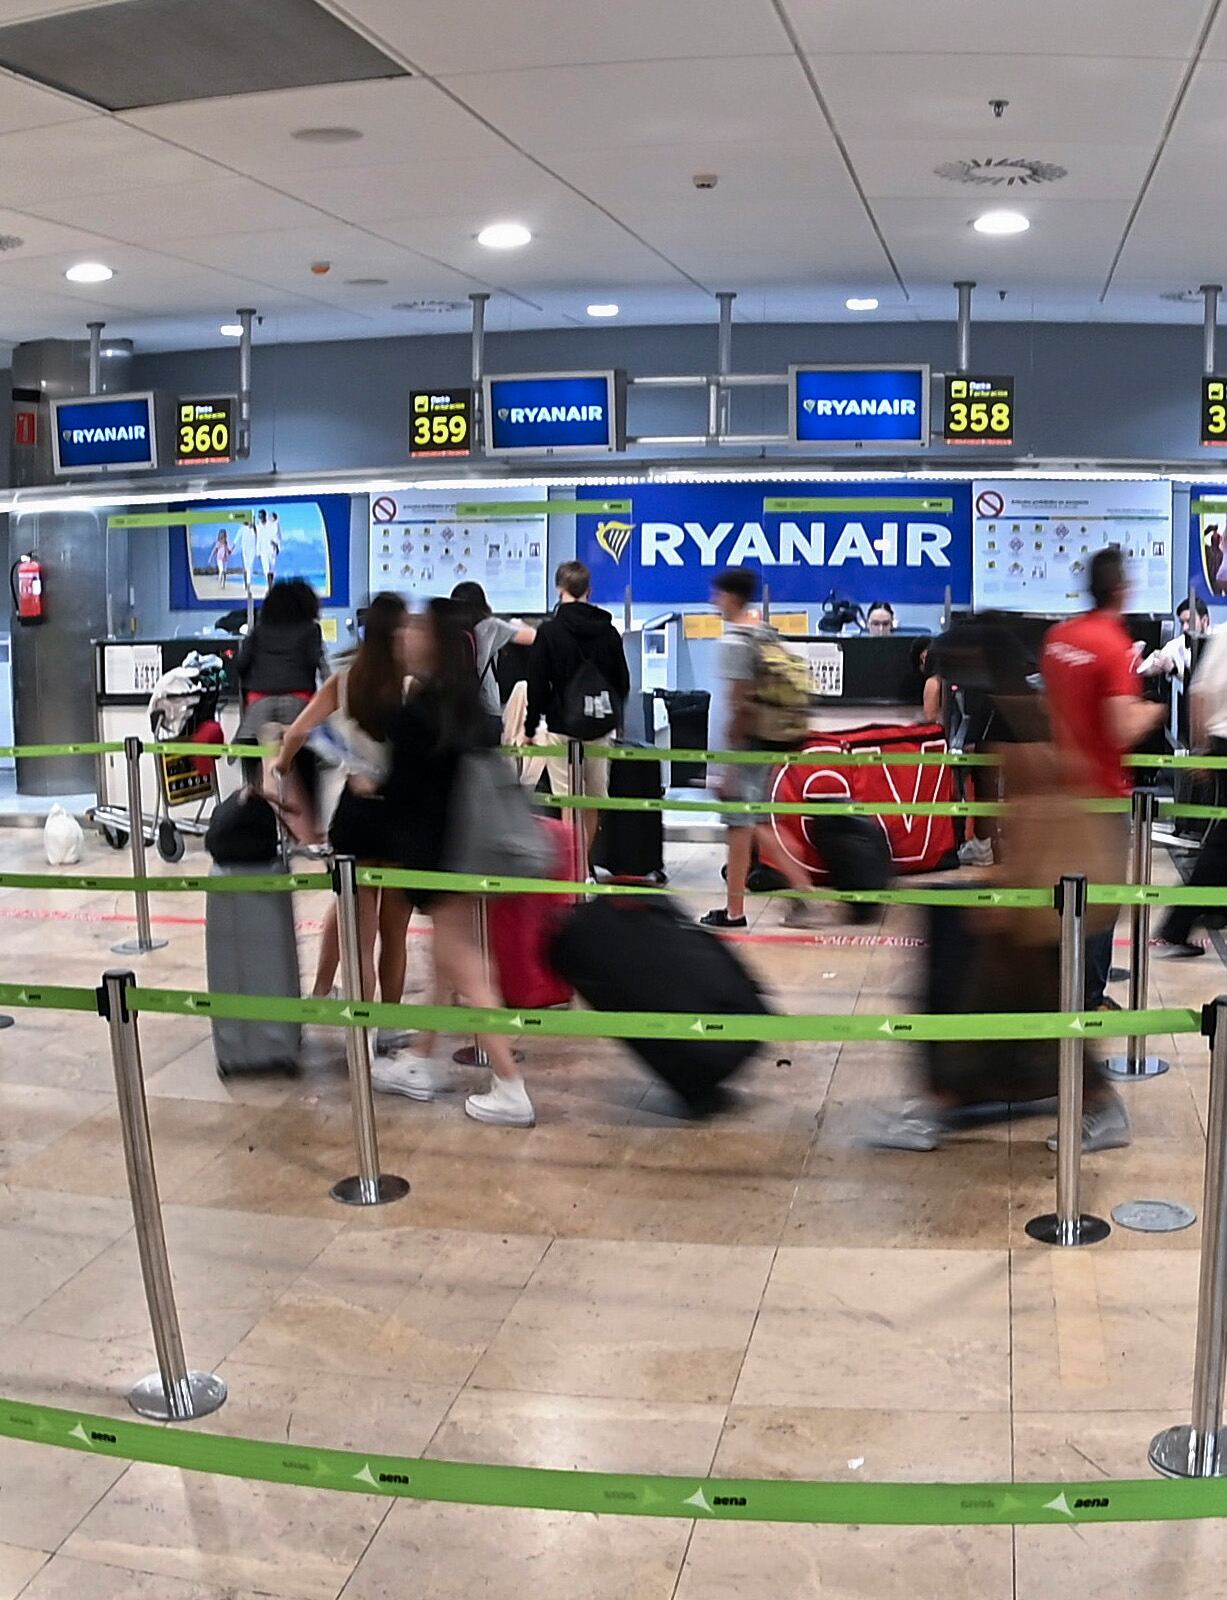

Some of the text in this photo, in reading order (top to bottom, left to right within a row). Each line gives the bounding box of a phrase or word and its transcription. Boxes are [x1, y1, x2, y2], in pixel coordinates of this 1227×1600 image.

[511, 405, 602, 423] RYANAIR
[817, 399, 915, 416] RYANAIR
[950, 402, 1010, 432] 358
[73, 425, 145, 444] RYANAIR
[180, 423, 228, 452] 360
[414, 416, 467, 444] 359
[641, 522, 952, 567] RYANAIR
[91, 1432, 117, 1444] aena
[379, 1473, 409, 1485] aena
[713, 1494, 747, 1506] aena
[1074, 1497, 1109, 1509] aena
